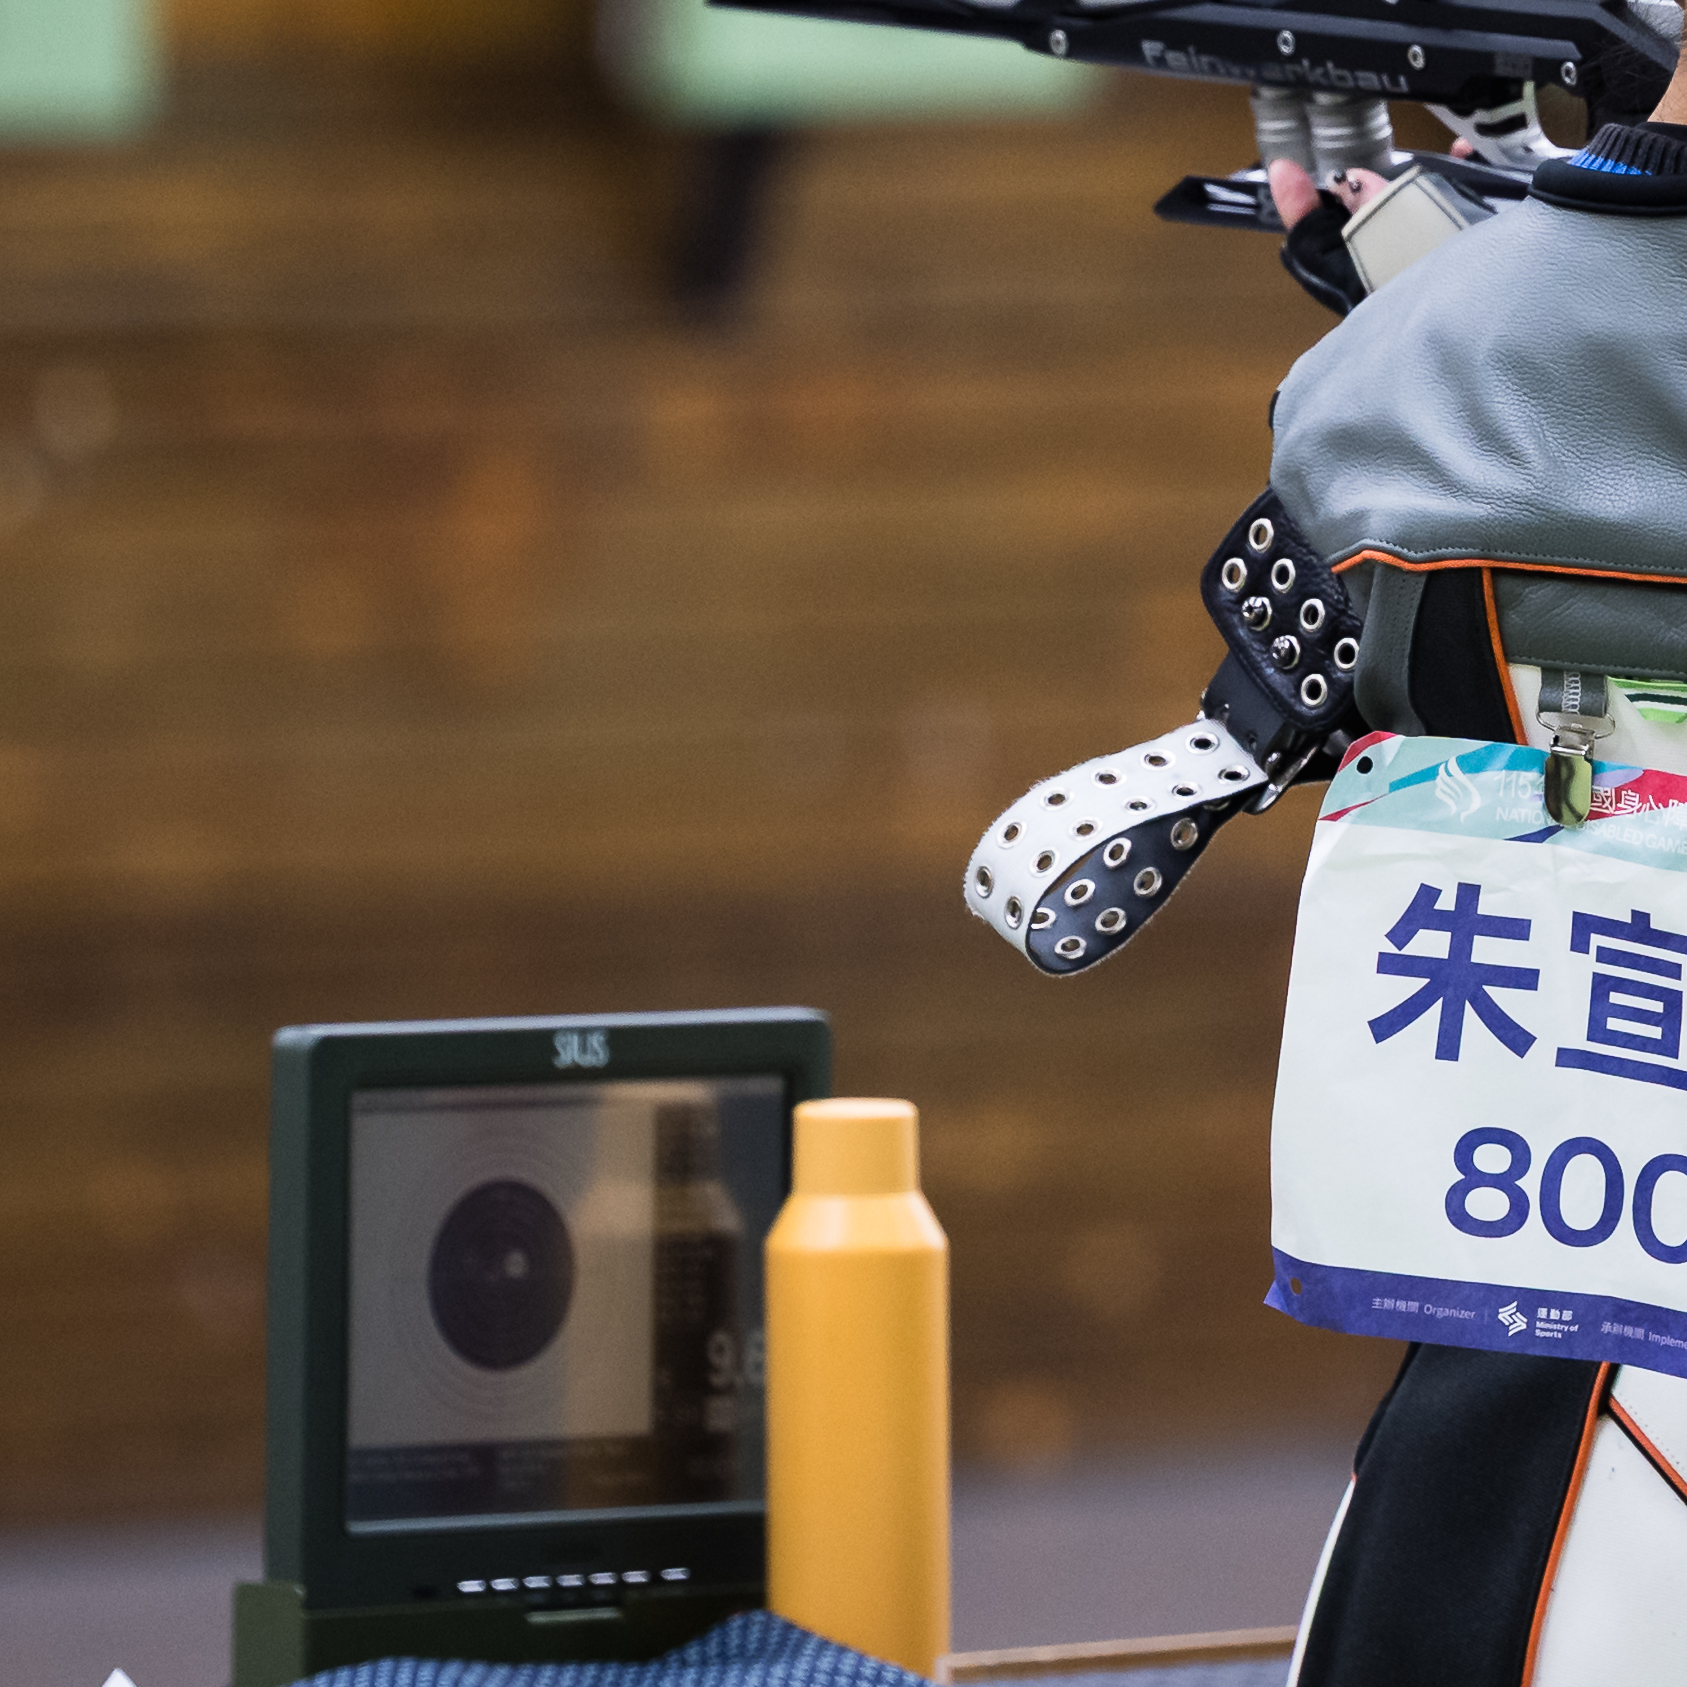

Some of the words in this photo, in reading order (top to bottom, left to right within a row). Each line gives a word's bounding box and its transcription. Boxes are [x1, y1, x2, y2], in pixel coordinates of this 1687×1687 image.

[1423, 1303, 1477, 1319] Organizer
[1535, 1320, 1569, 1332] Ministry
[1569, 1324, 1579, 1332] of
[1535, 1328, 1563, 1339] Sports
